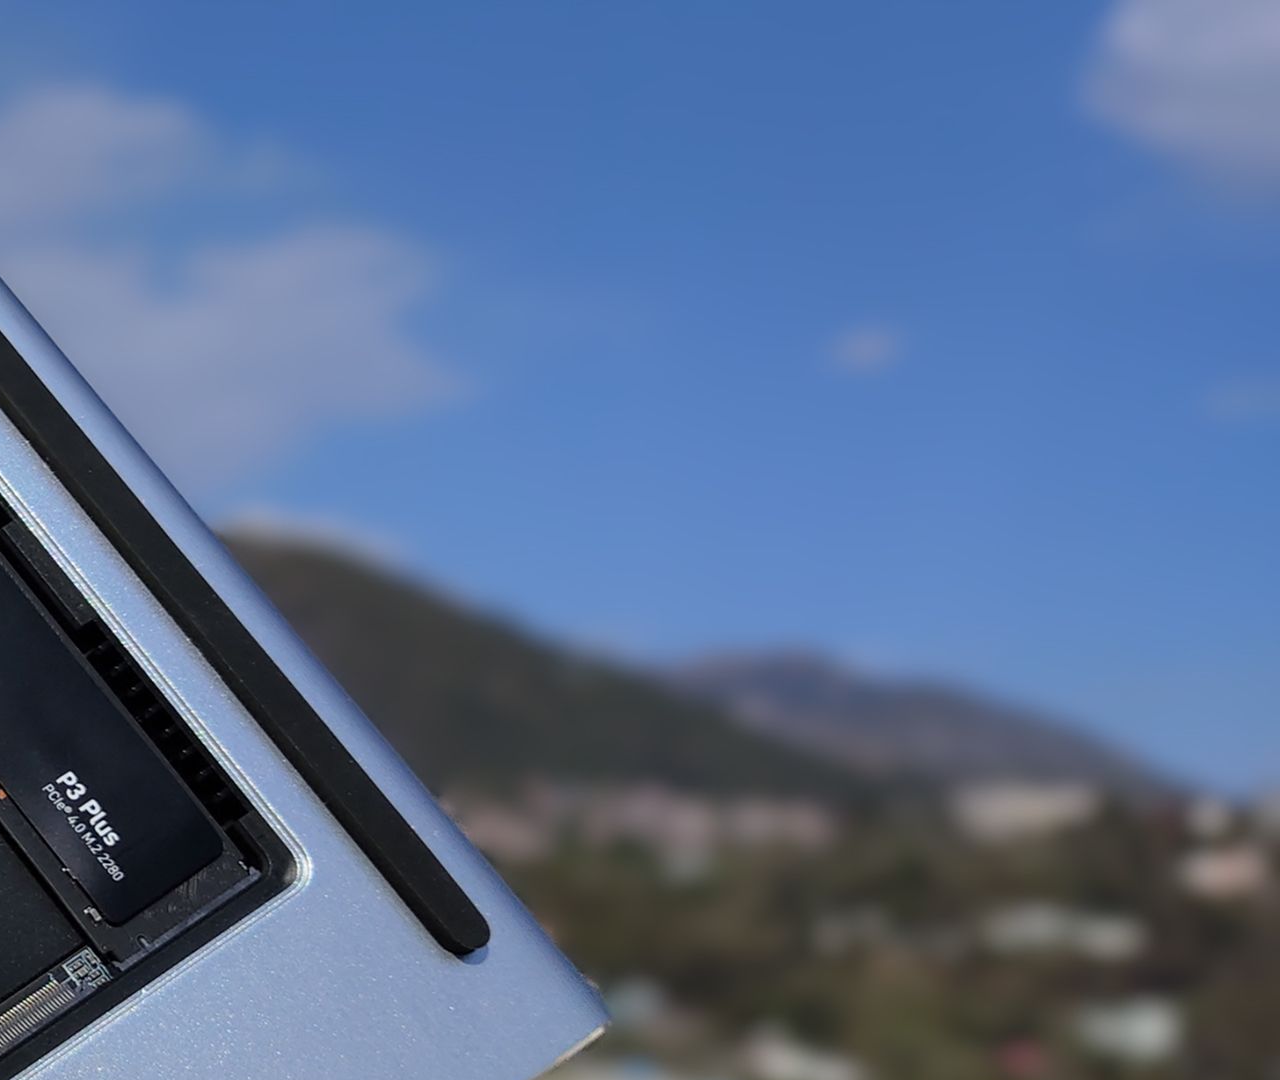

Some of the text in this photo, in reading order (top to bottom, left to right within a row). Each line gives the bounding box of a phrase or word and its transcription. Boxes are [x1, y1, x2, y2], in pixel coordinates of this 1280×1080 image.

[56, 770, 120, 847] P3 Plus
[67, 815, 87, 833] 4.0
[81, 832, 103, 855] M.2
[97, 852, 125, 881] 2280
